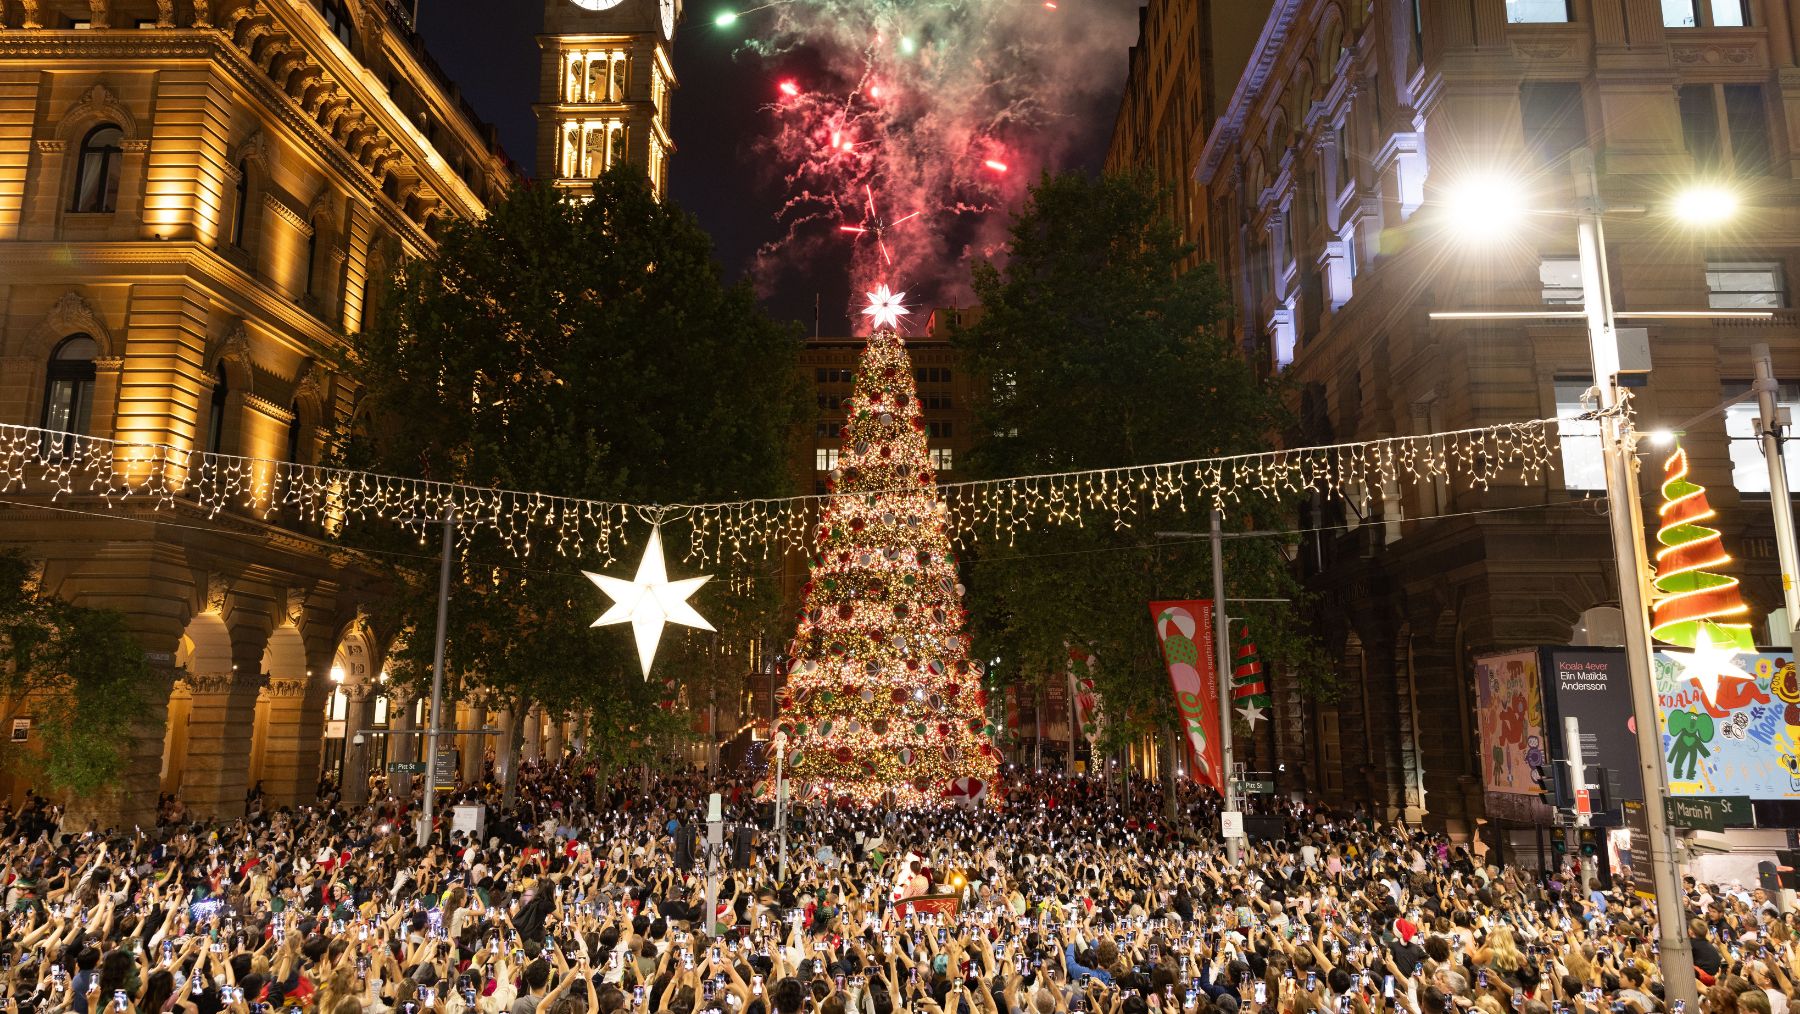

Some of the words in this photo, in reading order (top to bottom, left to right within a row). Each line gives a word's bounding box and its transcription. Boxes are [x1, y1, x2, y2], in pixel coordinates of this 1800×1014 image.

[1559, 661, 1583, 671] Koala
[1585, 661, 1608, 671] 4ever
[1560, 671, 1576, 681] Elin
[1577, 671, 1608, 681] Matilda
[1561, 681, 1607, 691] Andersson
[1658, 689, 1700, 708] KOALA
[1747, 702, 1784, 746] Koala
[1677, 801, 1703, 819] Martin
[1703, 805, 1713, 820] Pl
[1721, 799, 1733, 813] St
